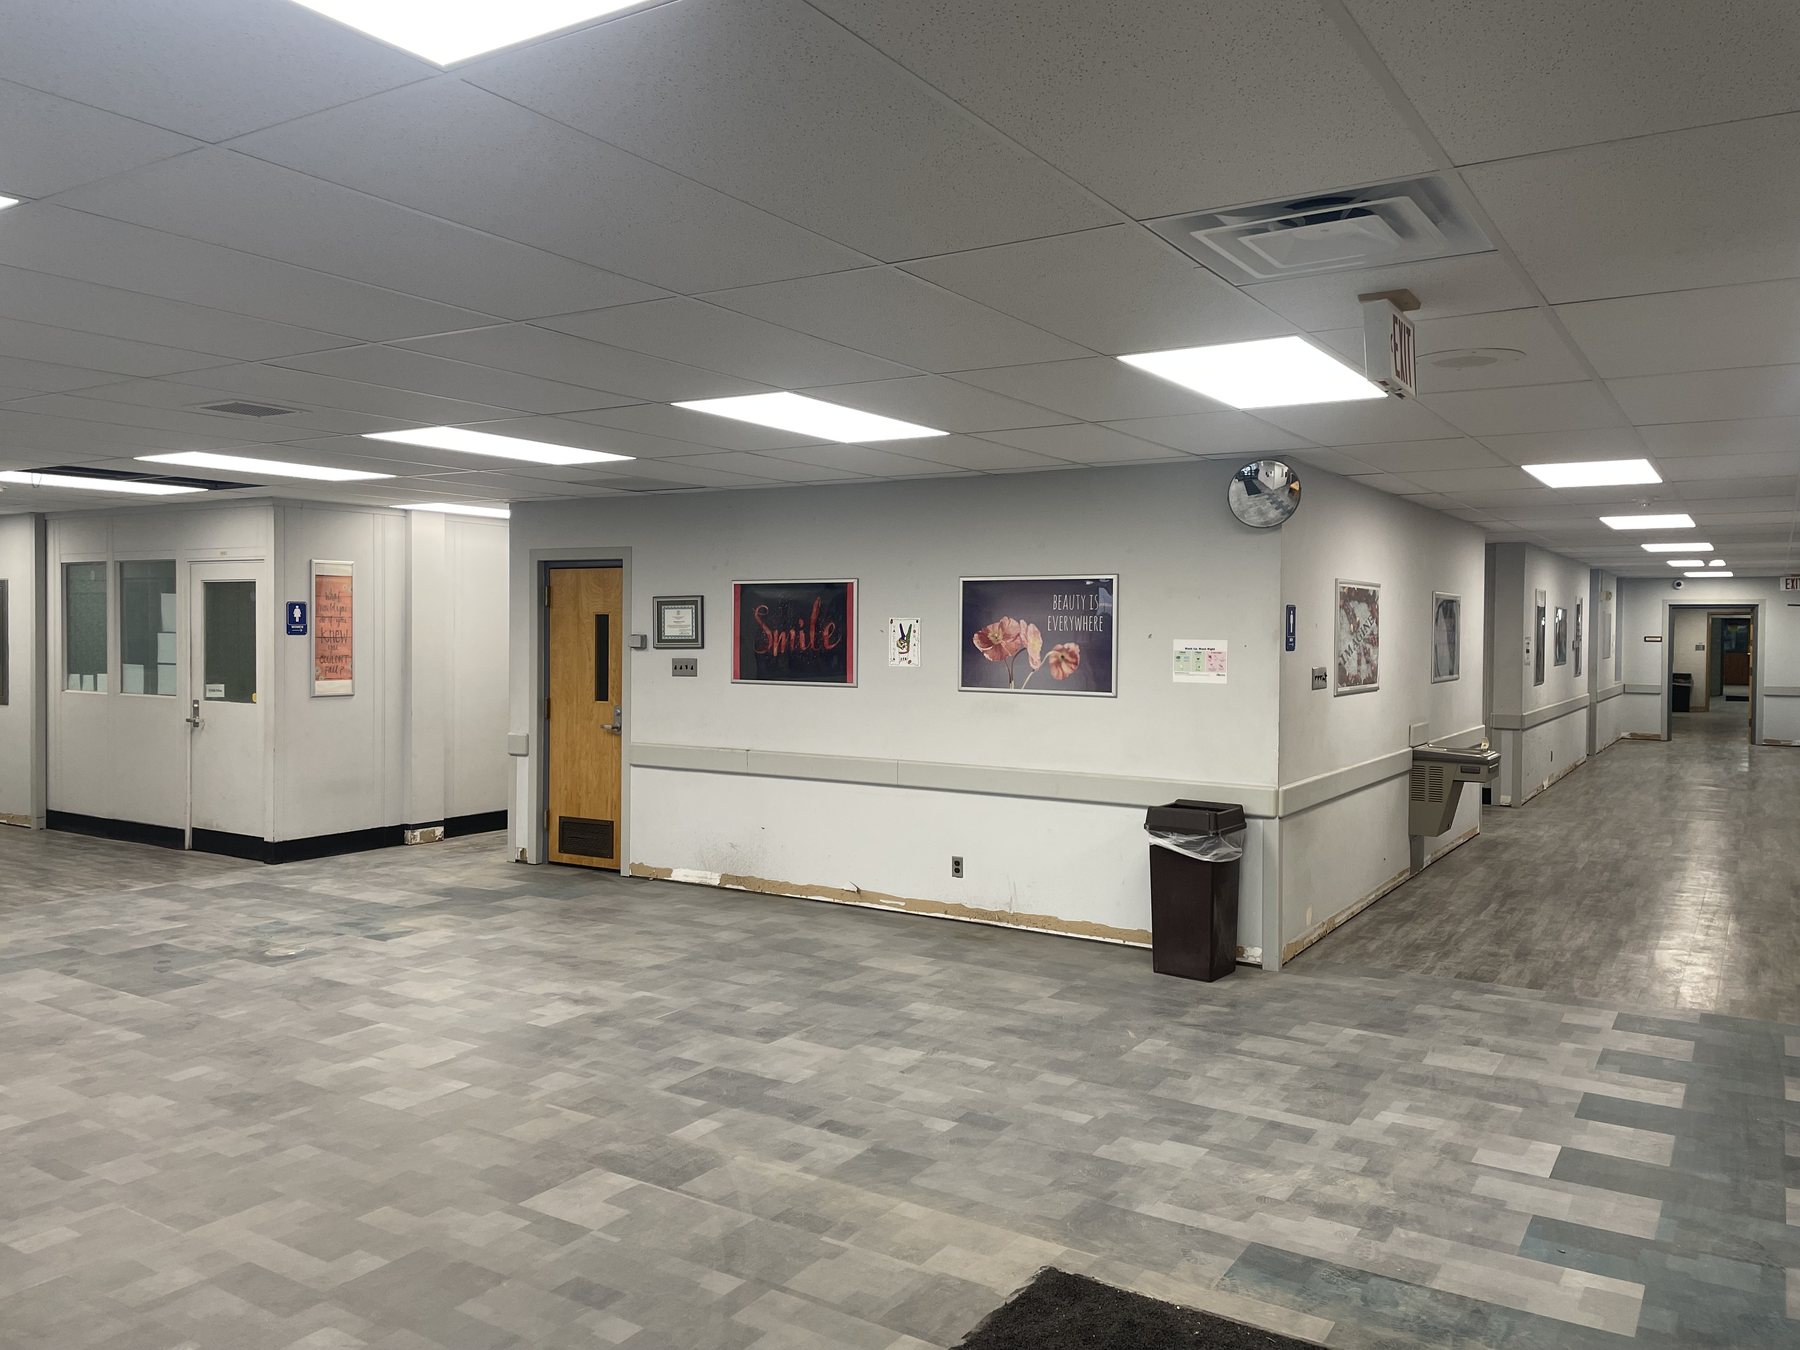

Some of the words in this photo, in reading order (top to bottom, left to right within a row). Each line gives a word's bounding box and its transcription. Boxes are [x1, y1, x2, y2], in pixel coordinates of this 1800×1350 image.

[1392, 313, 1412, 388] EXIT
[1785, 577, 1800, 590] EXI
[1052, 594, 1086, 611] BEAUTY
[1089, 594, 1099, 611] IS
[752, 596, 842, 657] Smile
[1047, 615, 1104, 632] EVERYWHERE
[1340, 614, 1376, 665] IMAGINE
